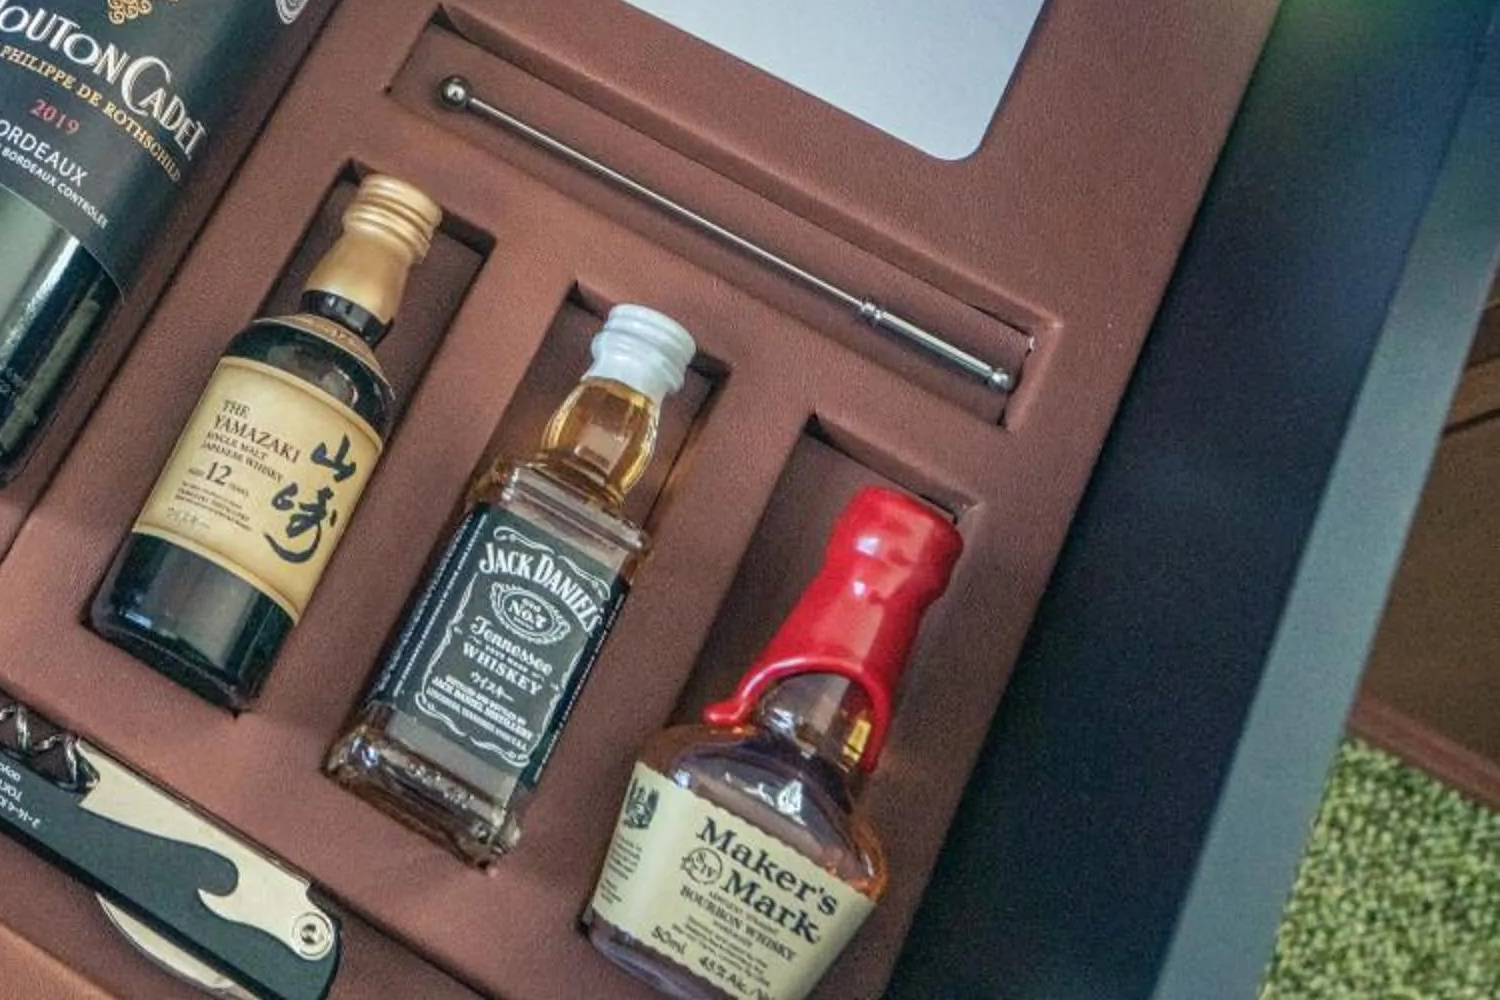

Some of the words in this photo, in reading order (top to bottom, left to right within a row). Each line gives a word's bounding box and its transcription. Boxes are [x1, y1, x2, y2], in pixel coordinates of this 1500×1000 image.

[0, 45, 77, 90] PHILIPPE
[77, 83, 104, 108] DE
[103, 101, 182, 184] ROTHSCHILD
[29, 99, 81, 135] 2019
[120, 55, 208, 161] CADET
[1, 147, 58, 188] BORDEAUX
[221, 400, 251, 418] THE
[212, 414, 301, 464] YAMAZAKI
[205, 461, 233, 487] 12
[264, 432, 358, 564] 山崎
[479, 542, 535, 581] JACK
[462, 641, 543, 696] WHISKEY
[469, 615, 553, 676] Tennessee
[697, 816, 838, 916] Maker's
[720, 869, 821, 945] Mark
